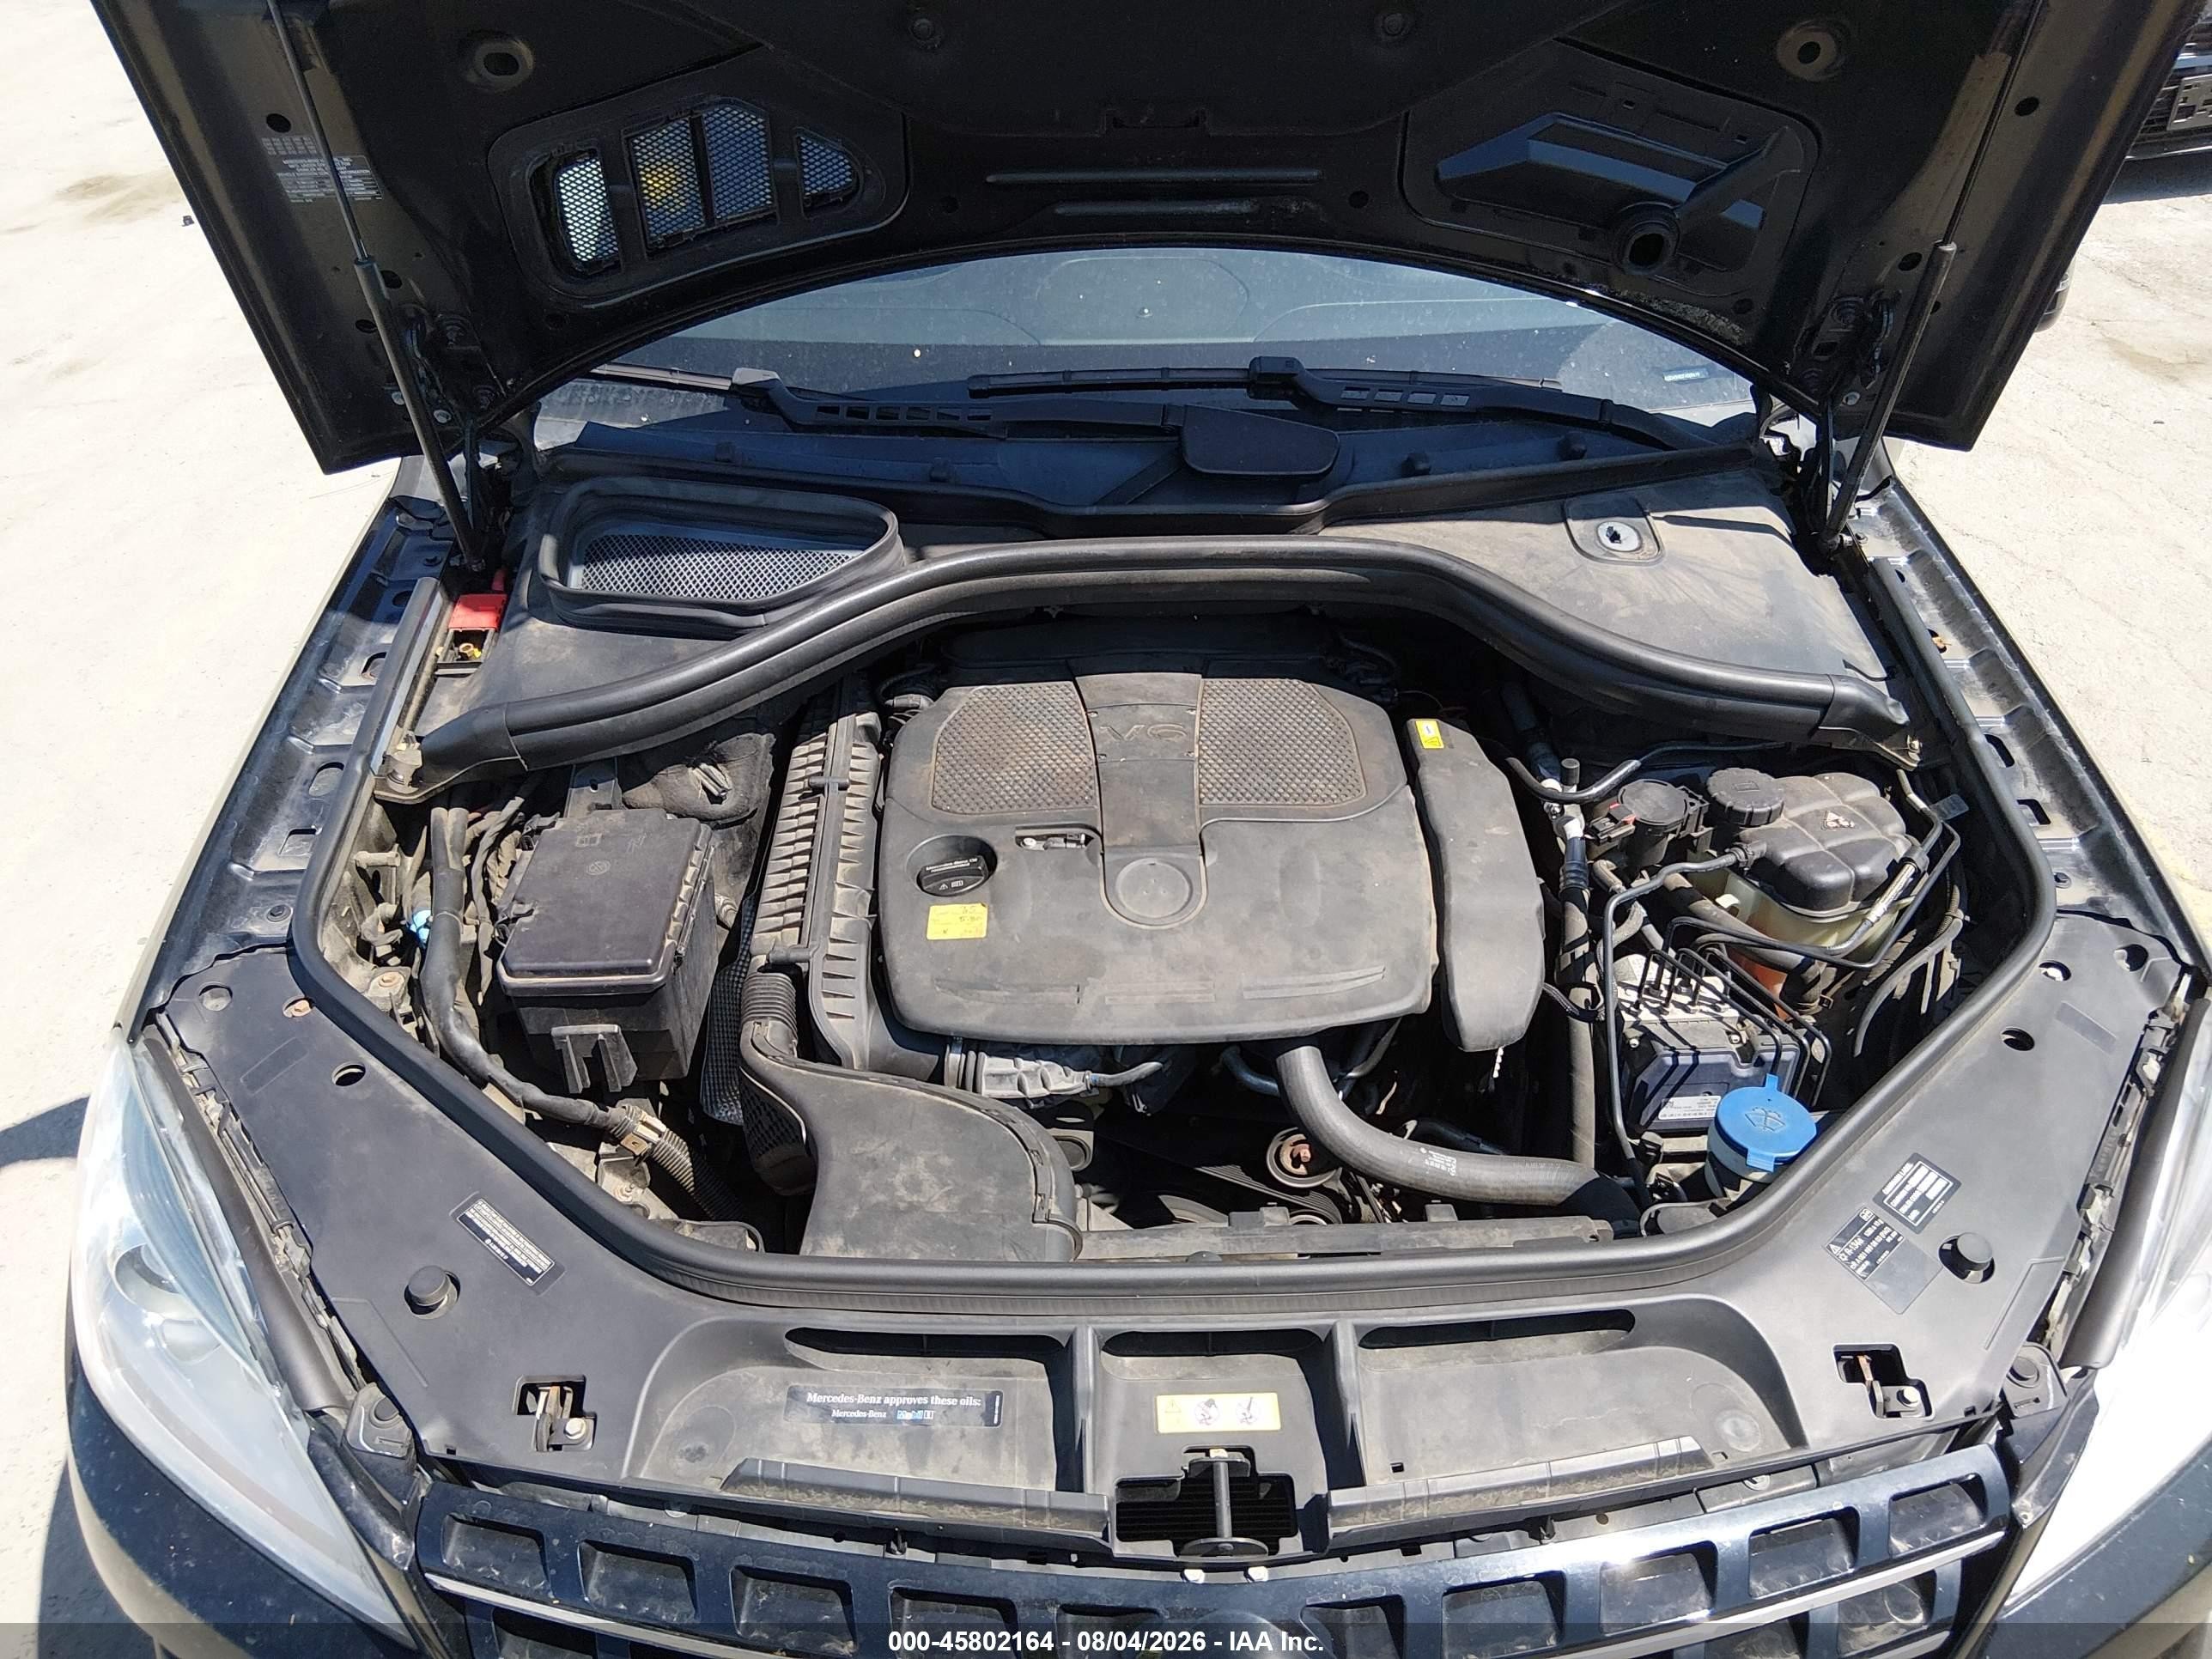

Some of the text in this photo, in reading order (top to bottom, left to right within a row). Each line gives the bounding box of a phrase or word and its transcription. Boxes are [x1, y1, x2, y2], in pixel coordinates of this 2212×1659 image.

[1099, 722, 1187, 742] V6
[806, 1392, 981, 1407] Mercedes-Benz approves these oils:
[831, 1409, 887, 1419] Mercedes-Benz
